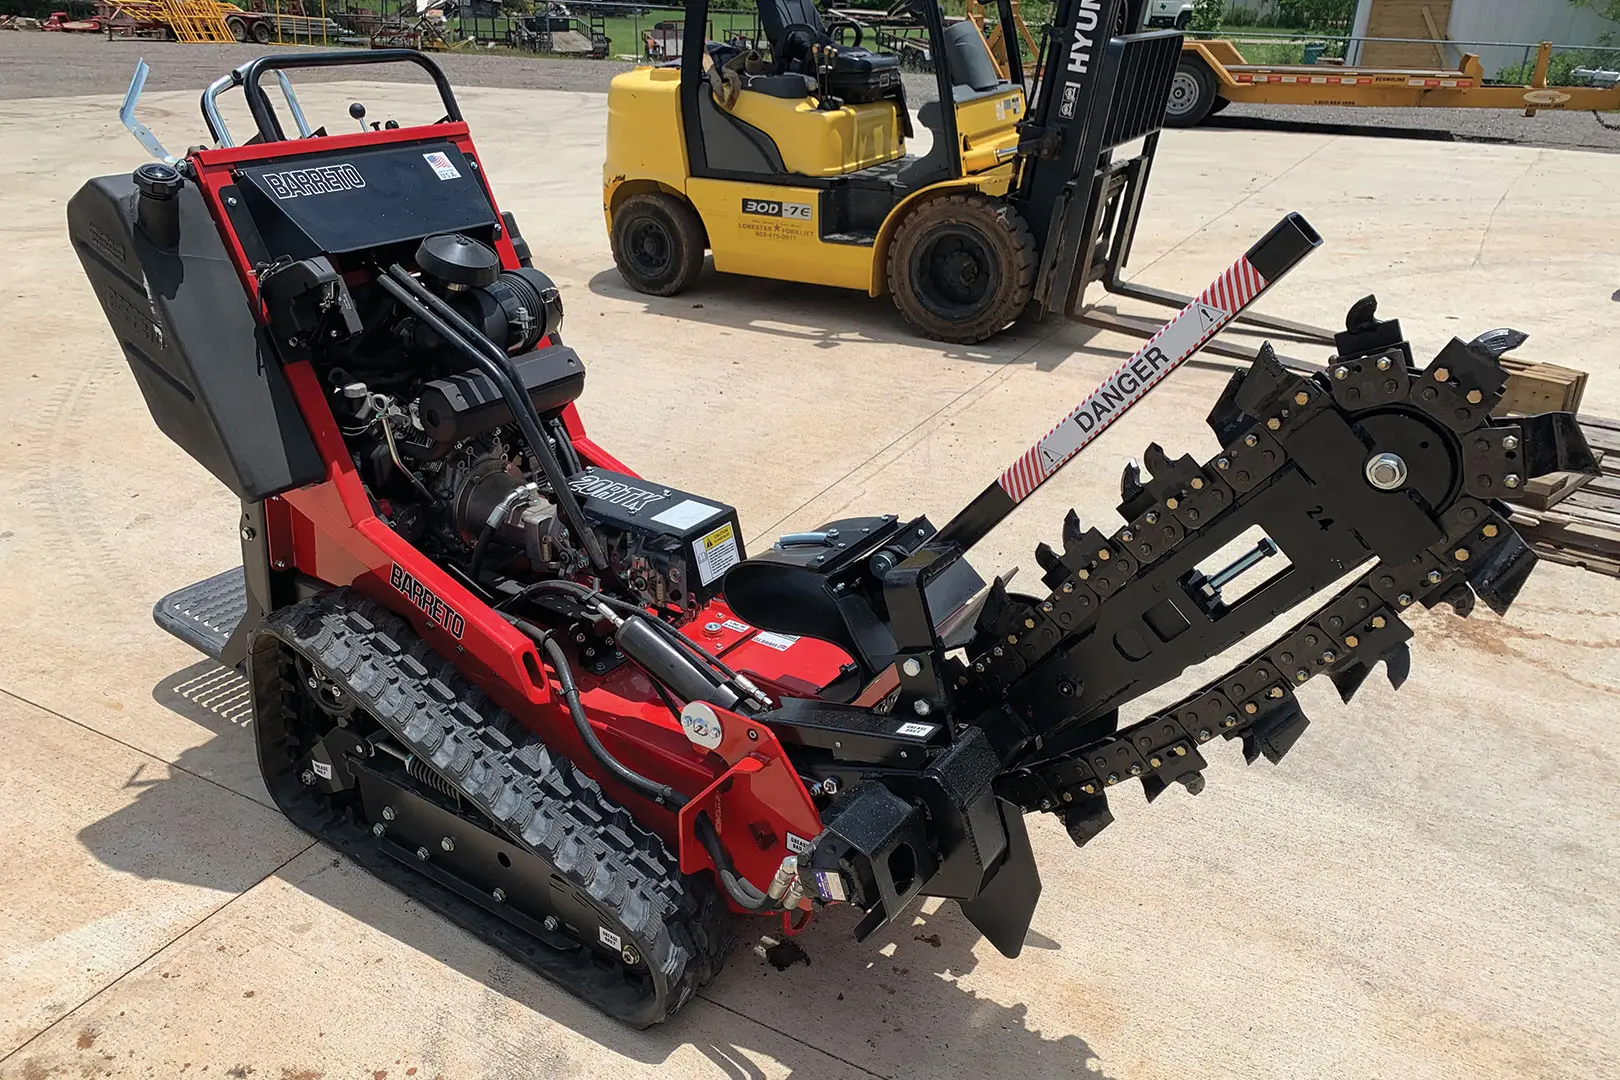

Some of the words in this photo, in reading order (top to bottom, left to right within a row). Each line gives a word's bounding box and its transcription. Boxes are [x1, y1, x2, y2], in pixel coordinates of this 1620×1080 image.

[262, 164, 366, 199] BARRETO
[1074, 346, 1170, 433] DANGER
[1306, 504, 1334, 532] 24
[389, 560, 465, 640] BARRETO
